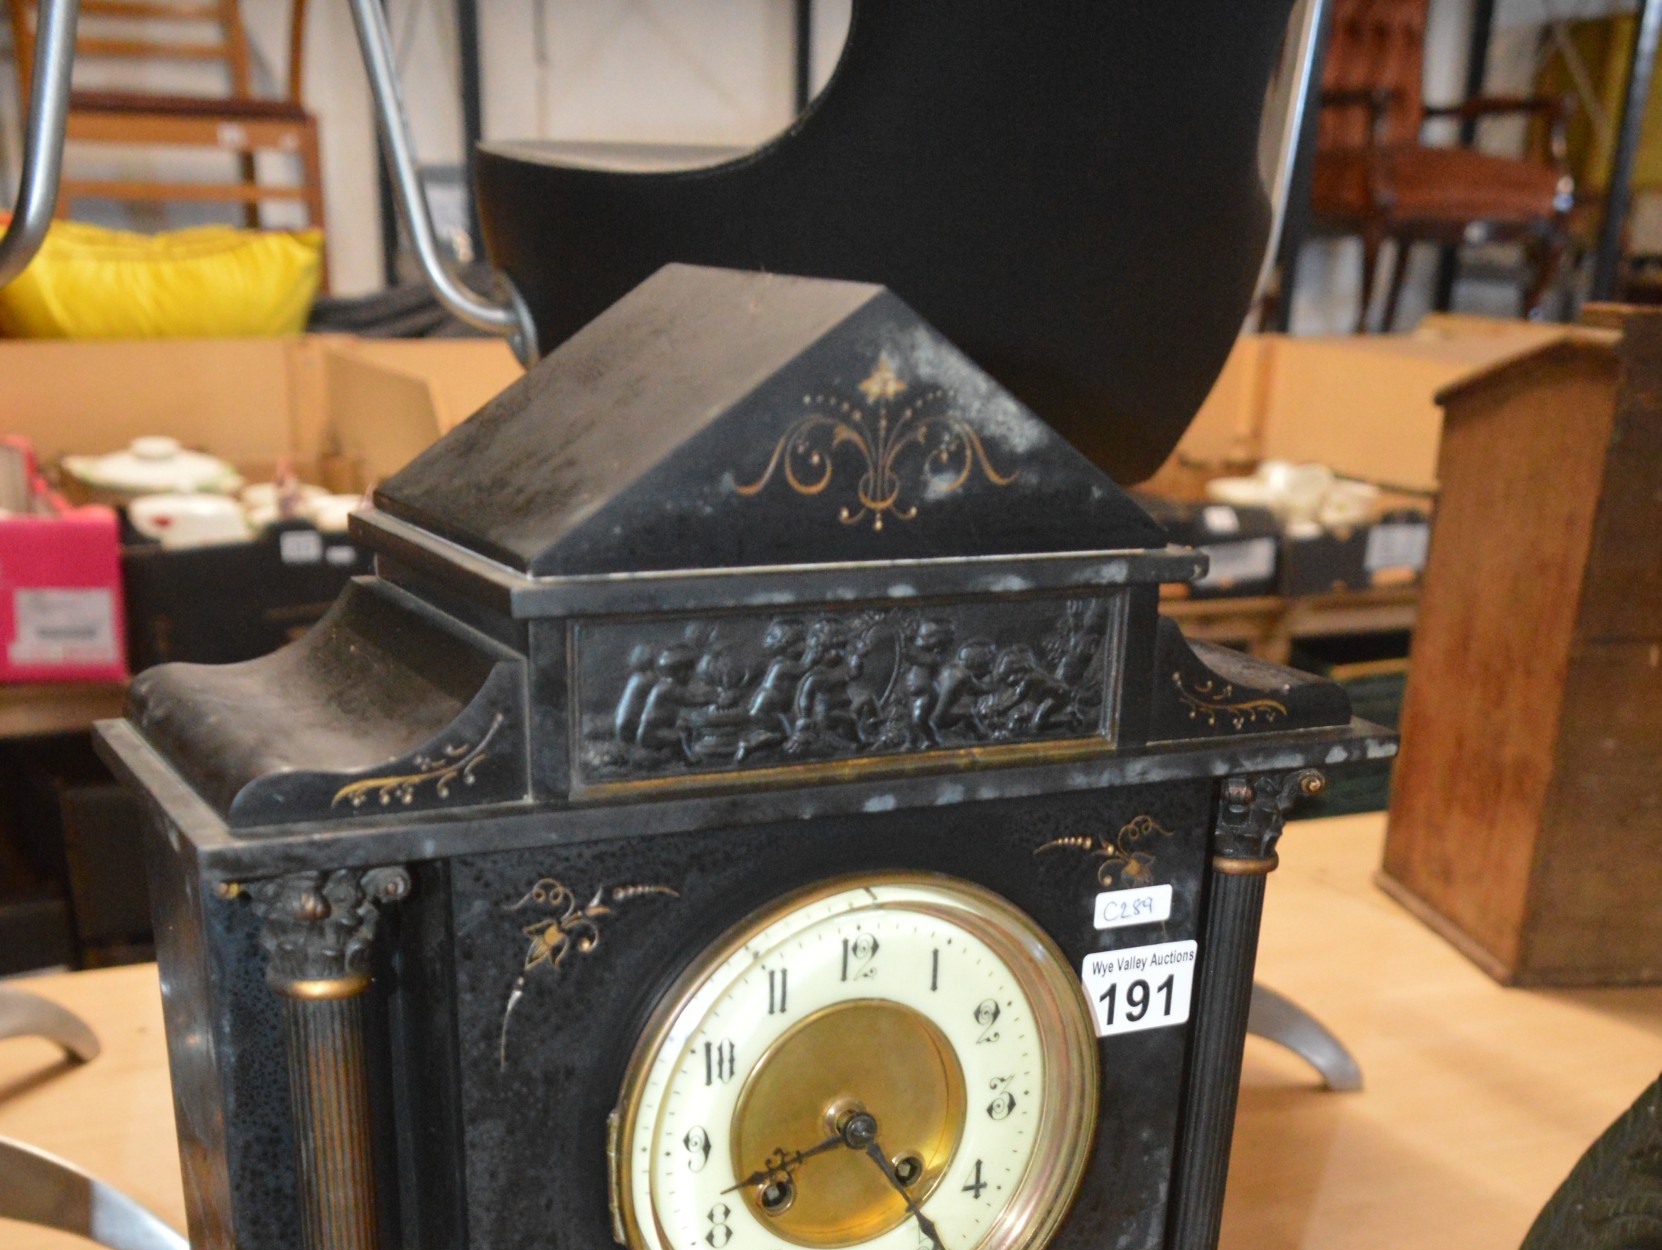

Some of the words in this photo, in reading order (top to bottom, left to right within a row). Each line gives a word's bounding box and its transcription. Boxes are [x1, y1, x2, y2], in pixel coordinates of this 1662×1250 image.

[1103, 897, 1154, 922] C289
[840, 933, 880, 982] 12
[931, 948, 940, 992] 1
[1092, 960, 1114, 978] Wye
[1117, 957, 1147, 972] Valley
[1150, 949, 1194, 967] Auctions
[768, 968, 787, 1014] 11
[1099, 973, 1174, 1026] 191
[974, 999, 1001, 1045] 2
[705, 1038, 736, 1086] 10
[986, 1075, 1017, 1121] 3
[682, 1125, 712, 1173] 9
[961, 1159, 988, 1199] 4
[705, 1202, 733, 1249] 8
